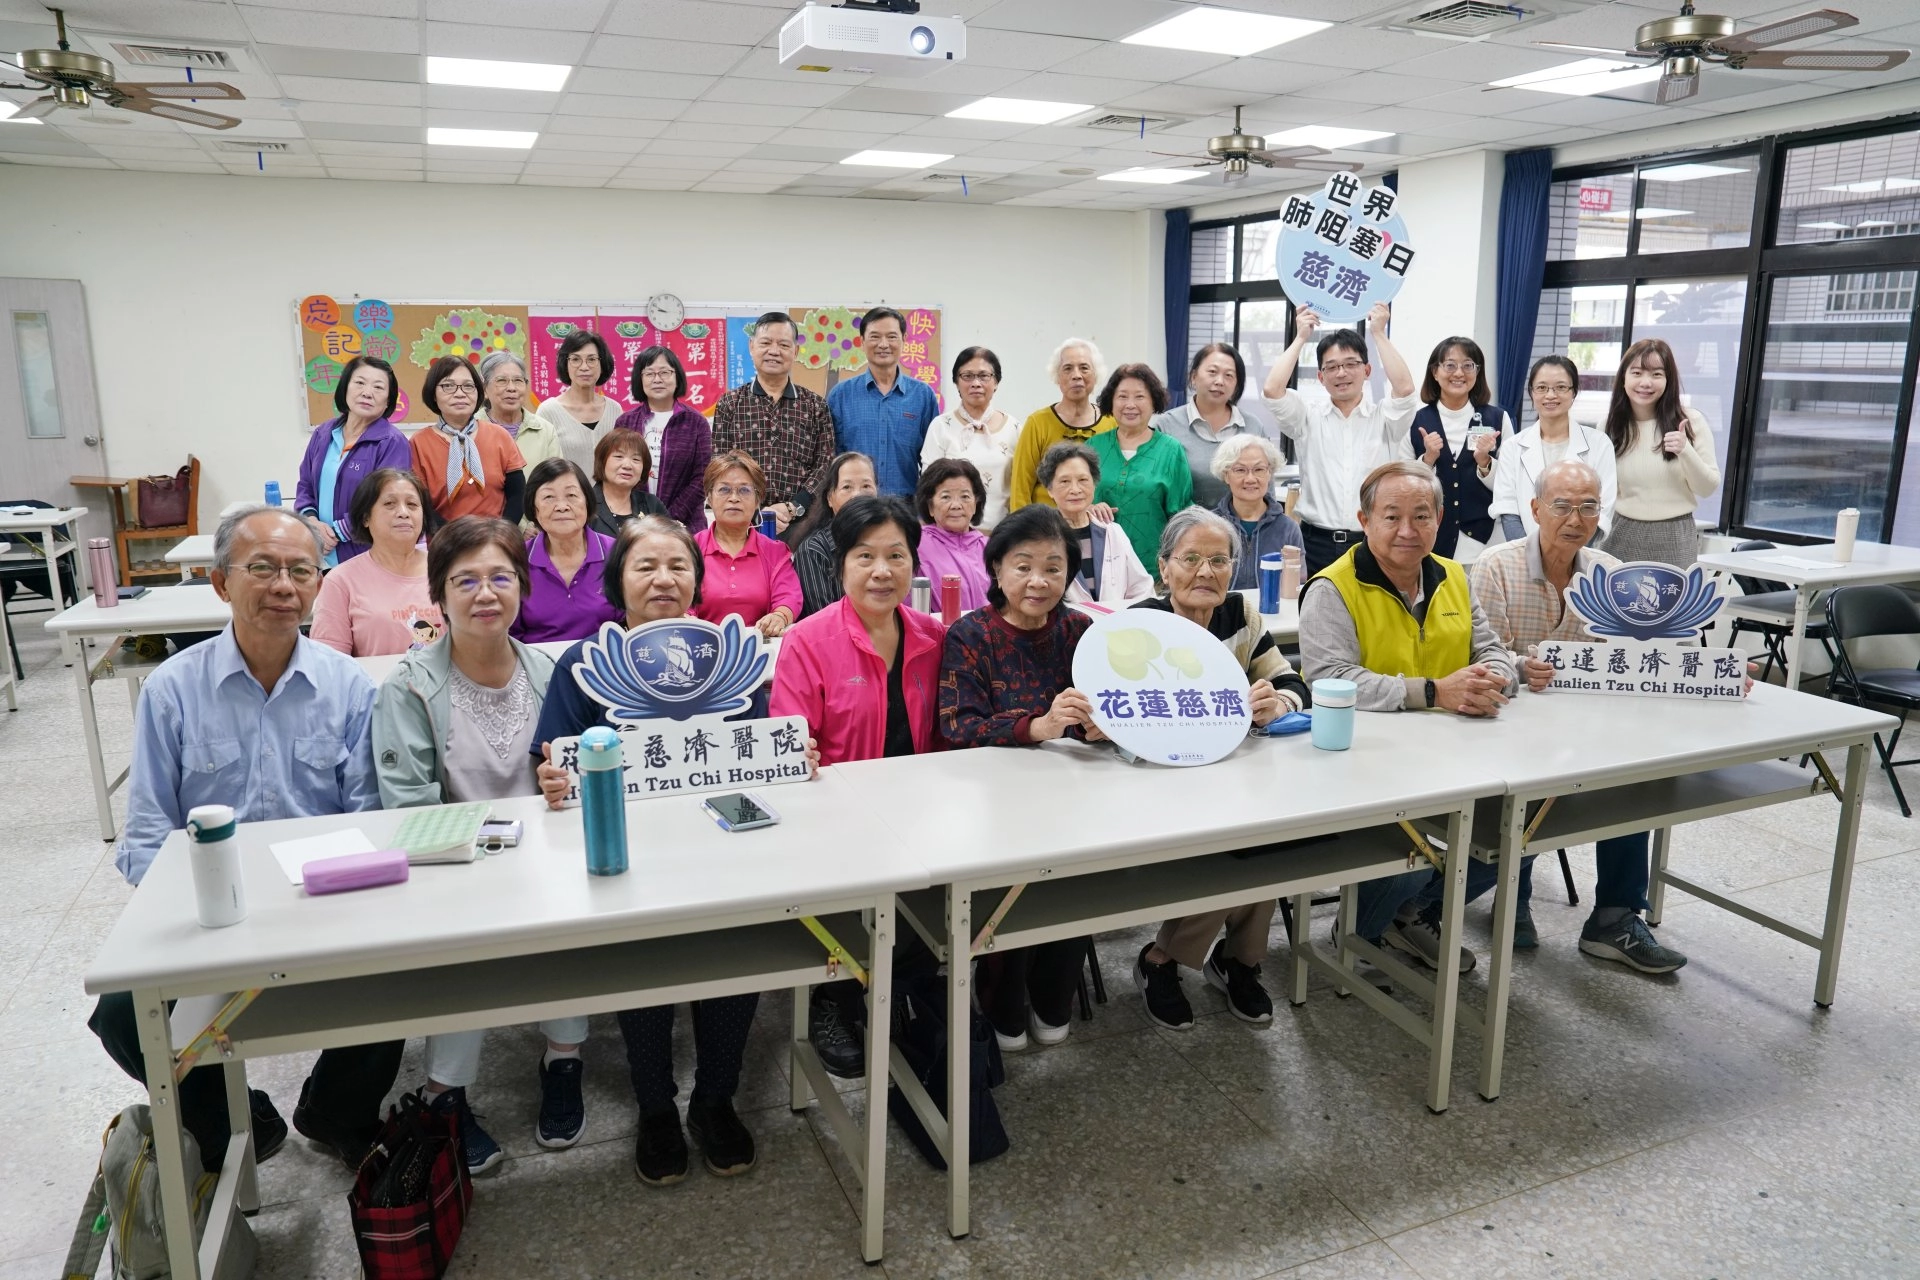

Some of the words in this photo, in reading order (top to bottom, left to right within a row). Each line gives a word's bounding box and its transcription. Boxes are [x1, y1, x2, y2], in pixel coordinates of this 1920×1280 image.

[1327, 174, 1394, 222] 世界
[1282, 196, 1415, 277] 肺阻塞日
[1293, 250, 1370, 306] 慈濟
[685, 342, 708, 405] 第一名
[391, 605, 438, 620] PINOCCH
[1544, 645, 1742, 680] 花蓮慈濟醫院
[1097, 688, 1246, 719] 花蓮慈濟
[1606, 680, 1634, 692] Tzu
[1640, 681, 1667, 694] Chi
[1673, 683, 1741, 699] Hospital
[560, 722, 805, 775] 花慈濟醫院
[645, 777, 682, 794] Tzu
[688, 770, 721, 787] Chi
[729, 761, 808, 784] Hospital
